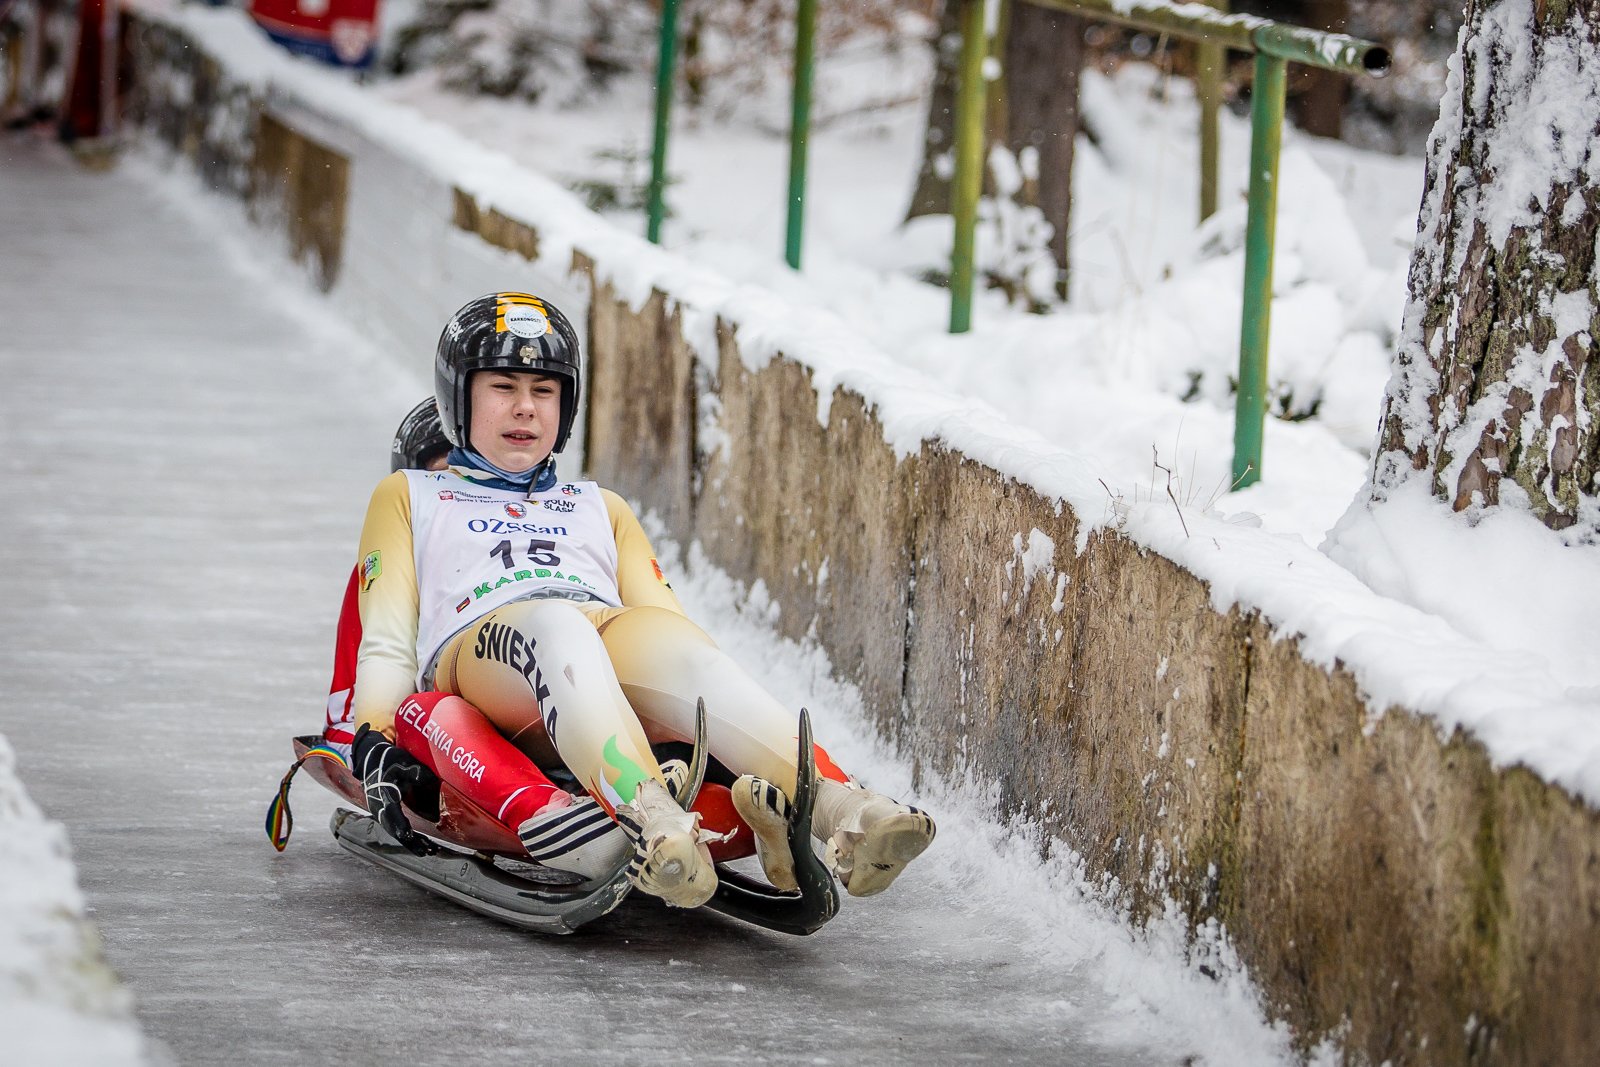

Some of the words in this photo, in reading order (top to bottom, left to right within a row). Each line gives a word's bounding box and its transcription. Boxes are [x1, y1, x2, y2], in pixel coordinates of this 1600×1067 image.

[489, 539, 561, 569] 15
[473, 569, 596, 600] KARPAC
[398, 699, 454, 757] JELENIA
[451, 746, 486, 783] GÓRA
